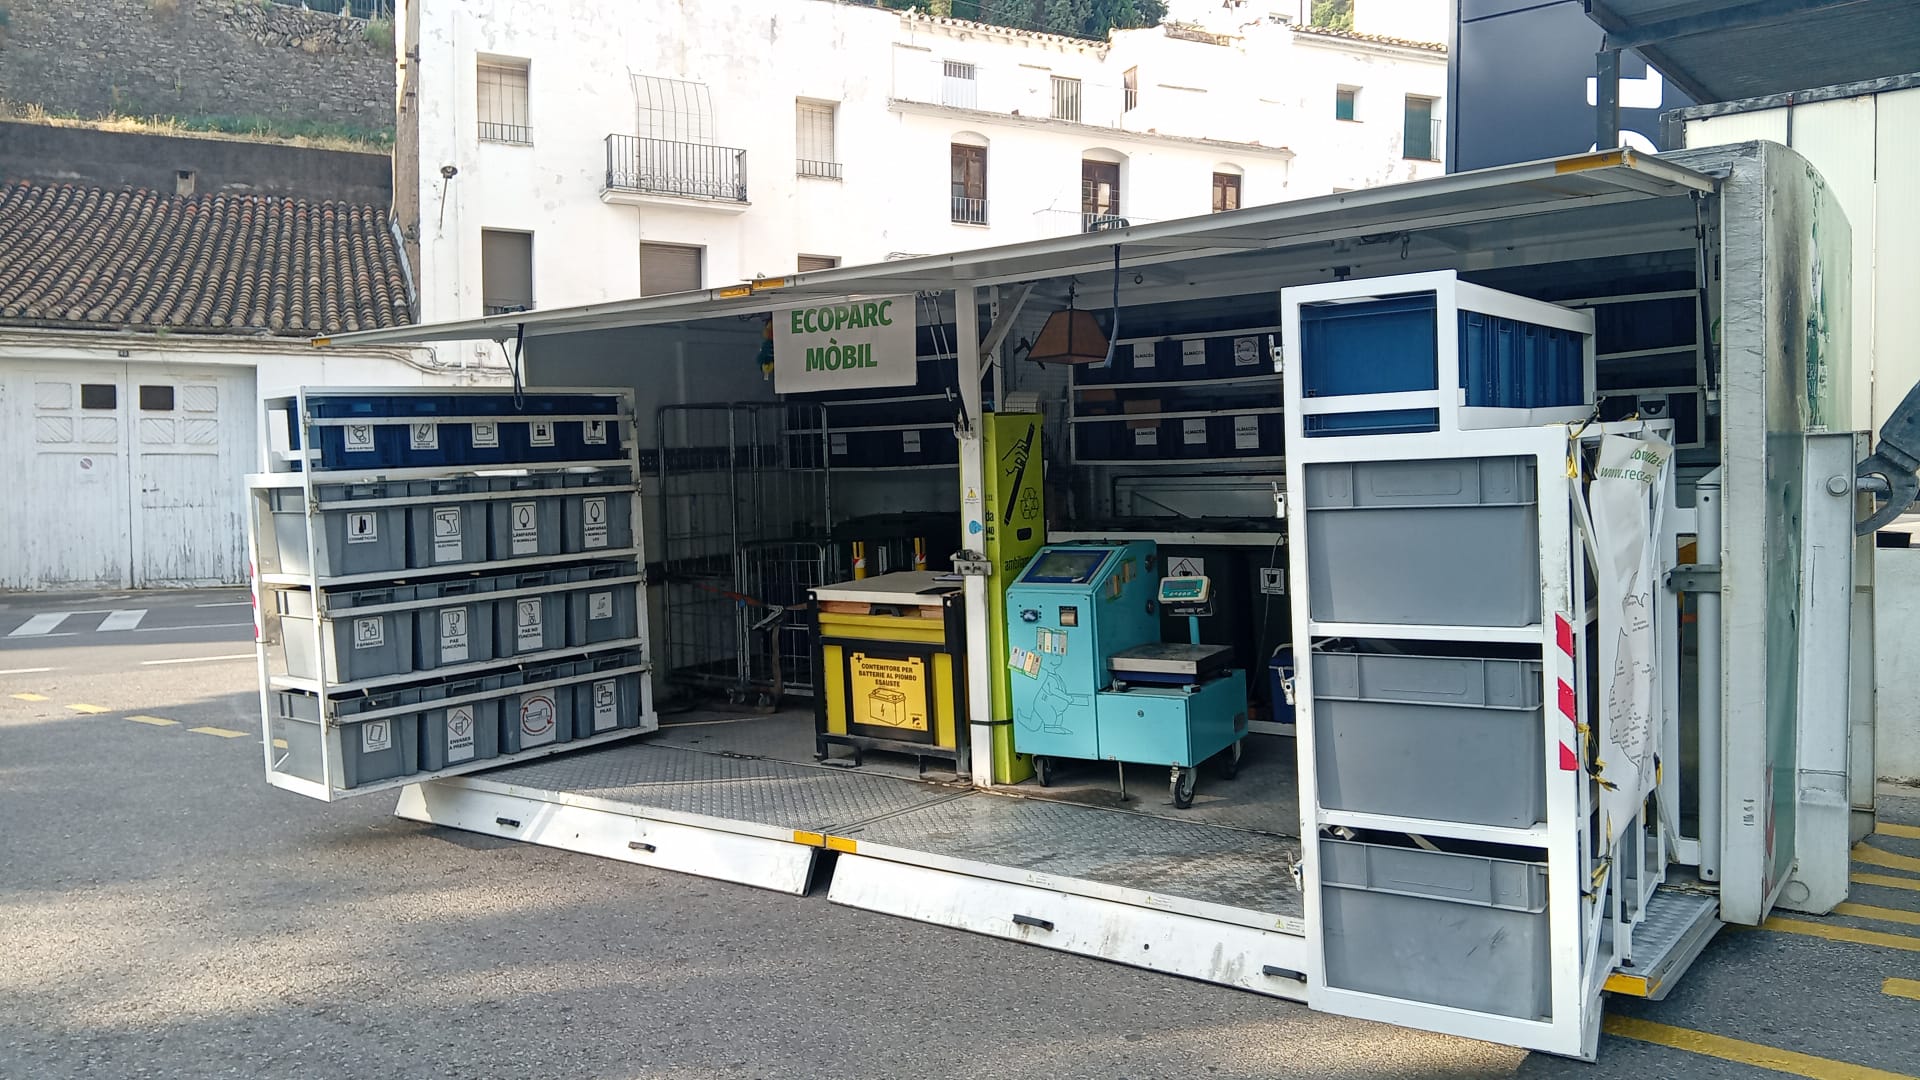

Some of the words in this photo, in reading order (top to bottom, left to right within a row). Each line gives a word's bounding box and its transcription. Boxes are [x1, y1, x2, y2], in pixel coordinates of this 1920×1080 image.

[791, 300, 893, 334] ECOPARC
[805, 337, 878, 372] MÒBIL
[861, 663, 900, 673] CONTENITORE
[858, 670, 885, 679] BATTERIE
[875, 679, 900, 687] ESAUSTE
[449, 736, 471, 745] ENVASES
